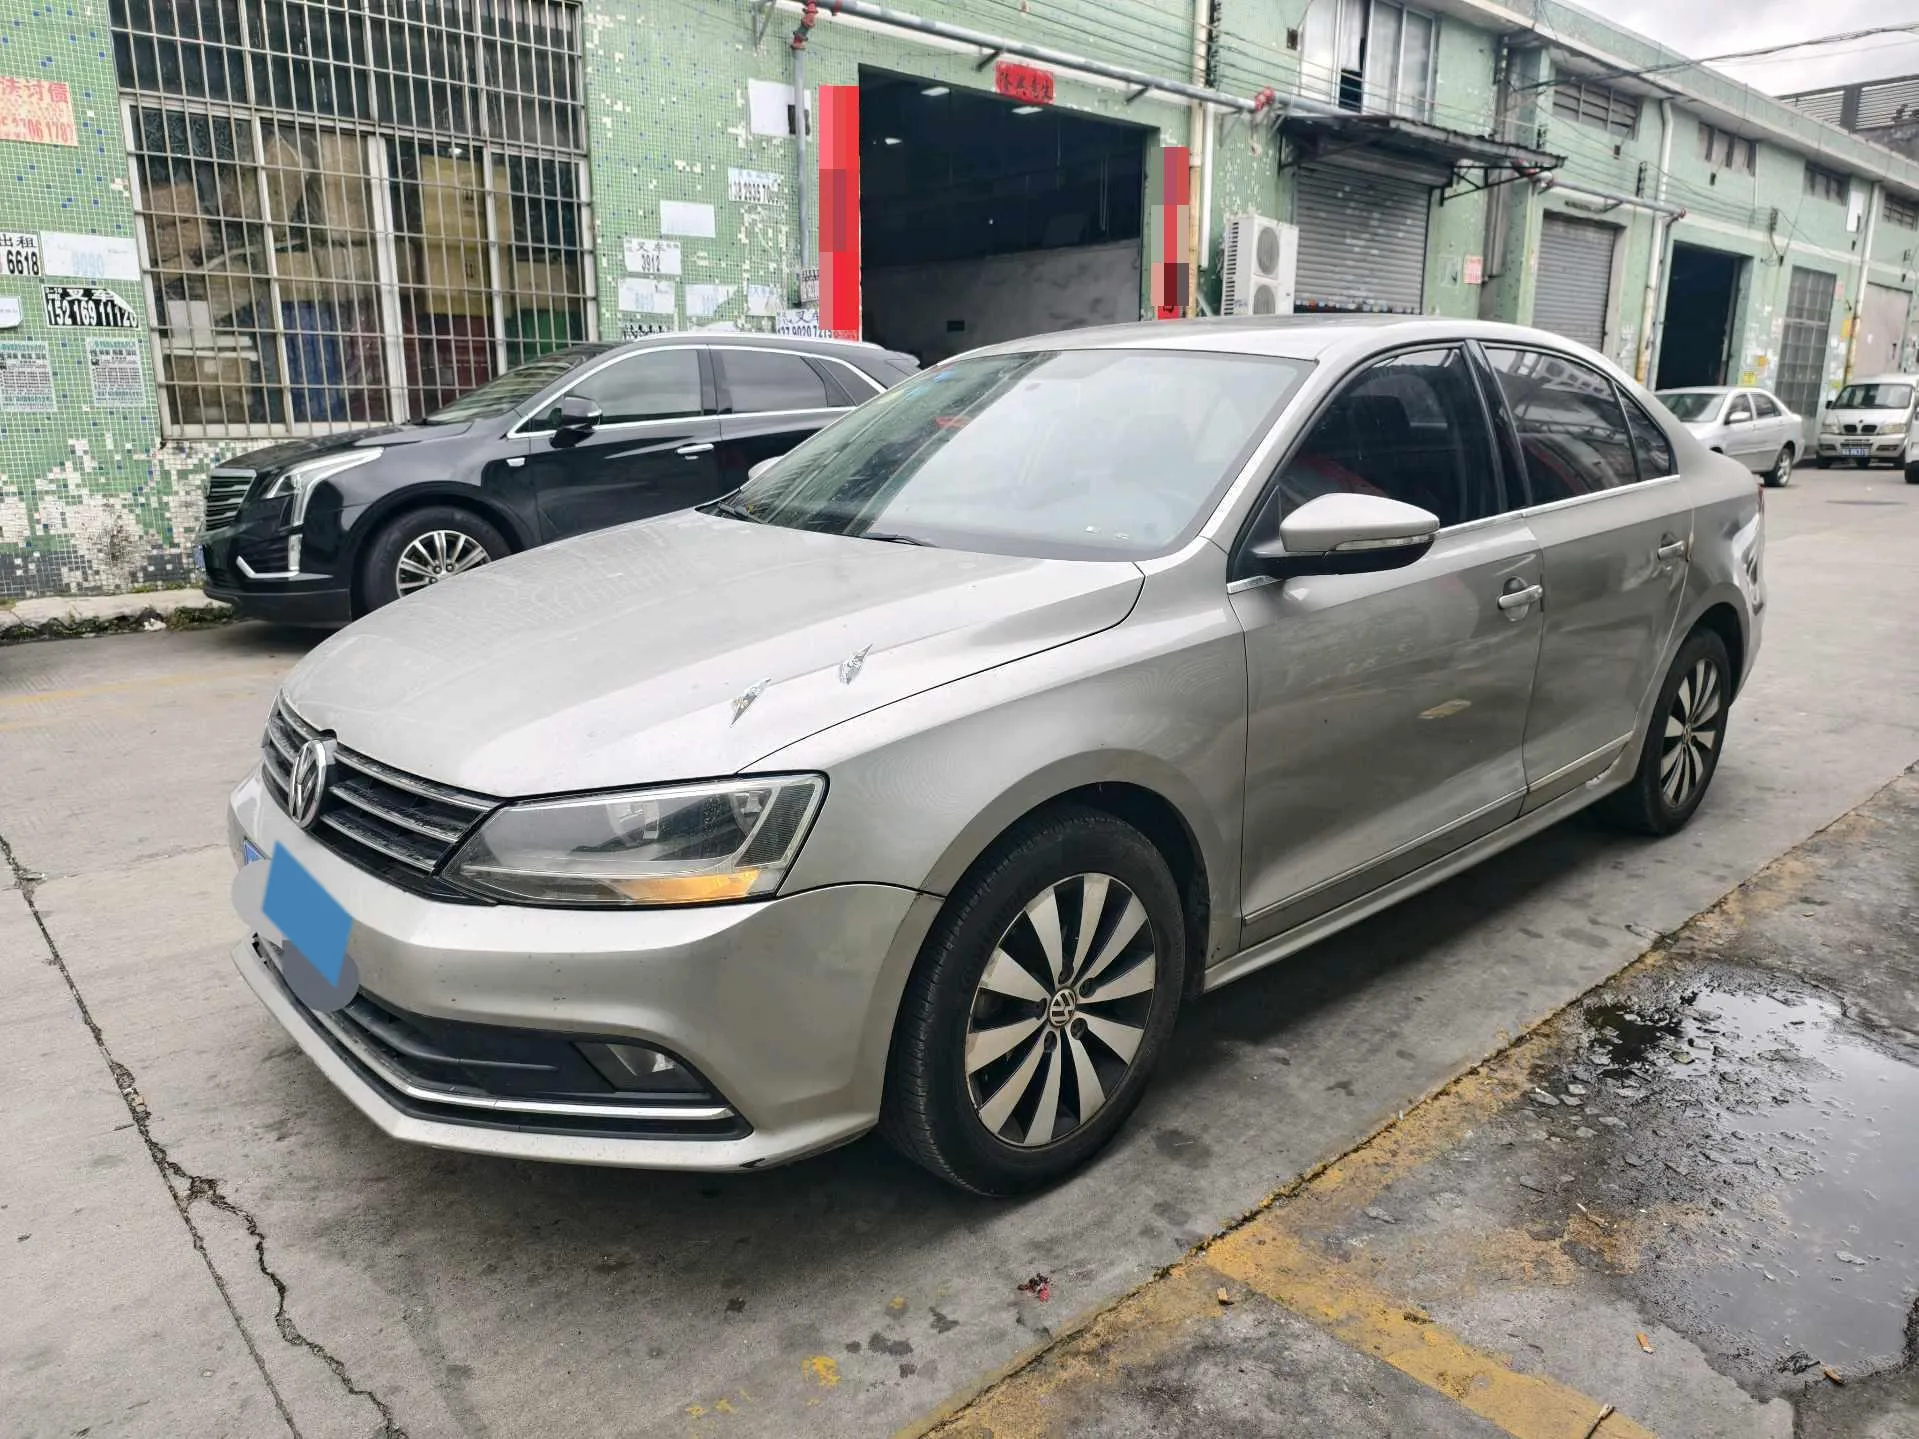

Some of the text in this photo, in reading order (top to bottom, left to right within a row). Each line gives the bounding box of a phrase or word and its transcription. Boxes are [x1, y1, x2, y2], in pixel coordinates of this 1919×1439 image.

[0, 234, 36, 249] 出租
[7, 249, 40, 276] 6618
[48, 299, 73, 326] 152
[73, 299, 97, 326] 169
